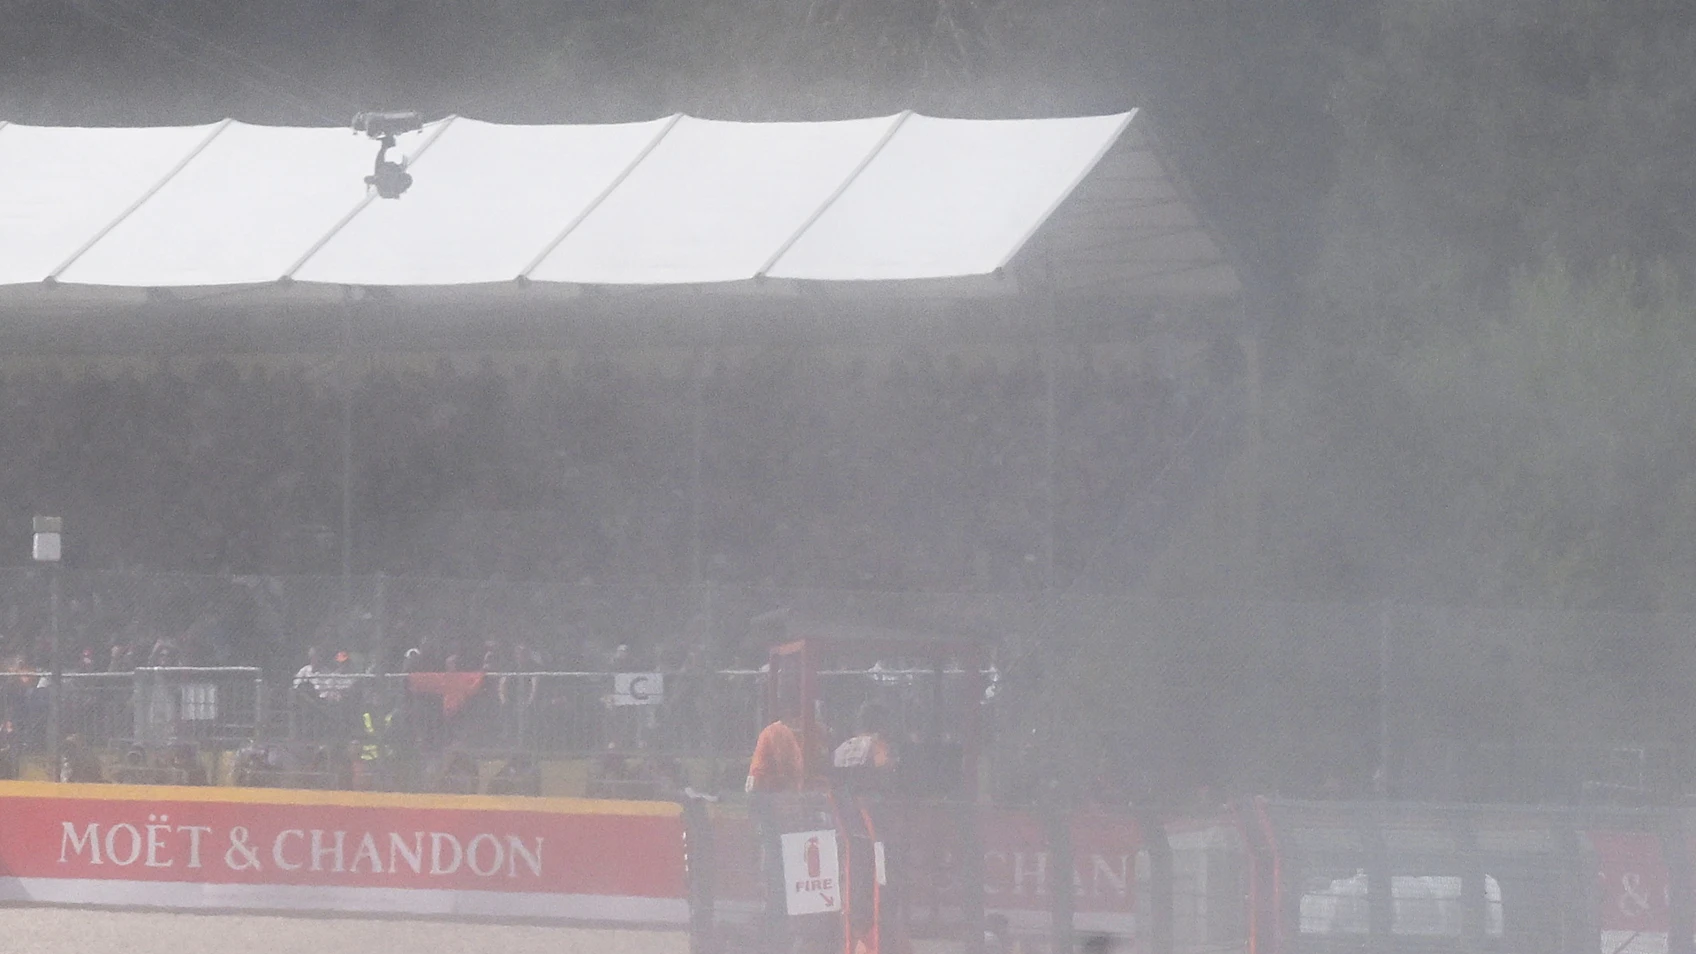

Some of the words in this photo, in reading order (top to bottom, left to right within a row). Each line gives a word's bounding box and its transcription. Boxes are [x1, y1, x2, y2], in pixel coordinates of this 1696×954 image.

[58, 814, 211, 868] MOËT
[224, 826, 262, 870] &
[272, 828, 545, 877] CHANDON
[796, 878, 833, 892] FIRE
